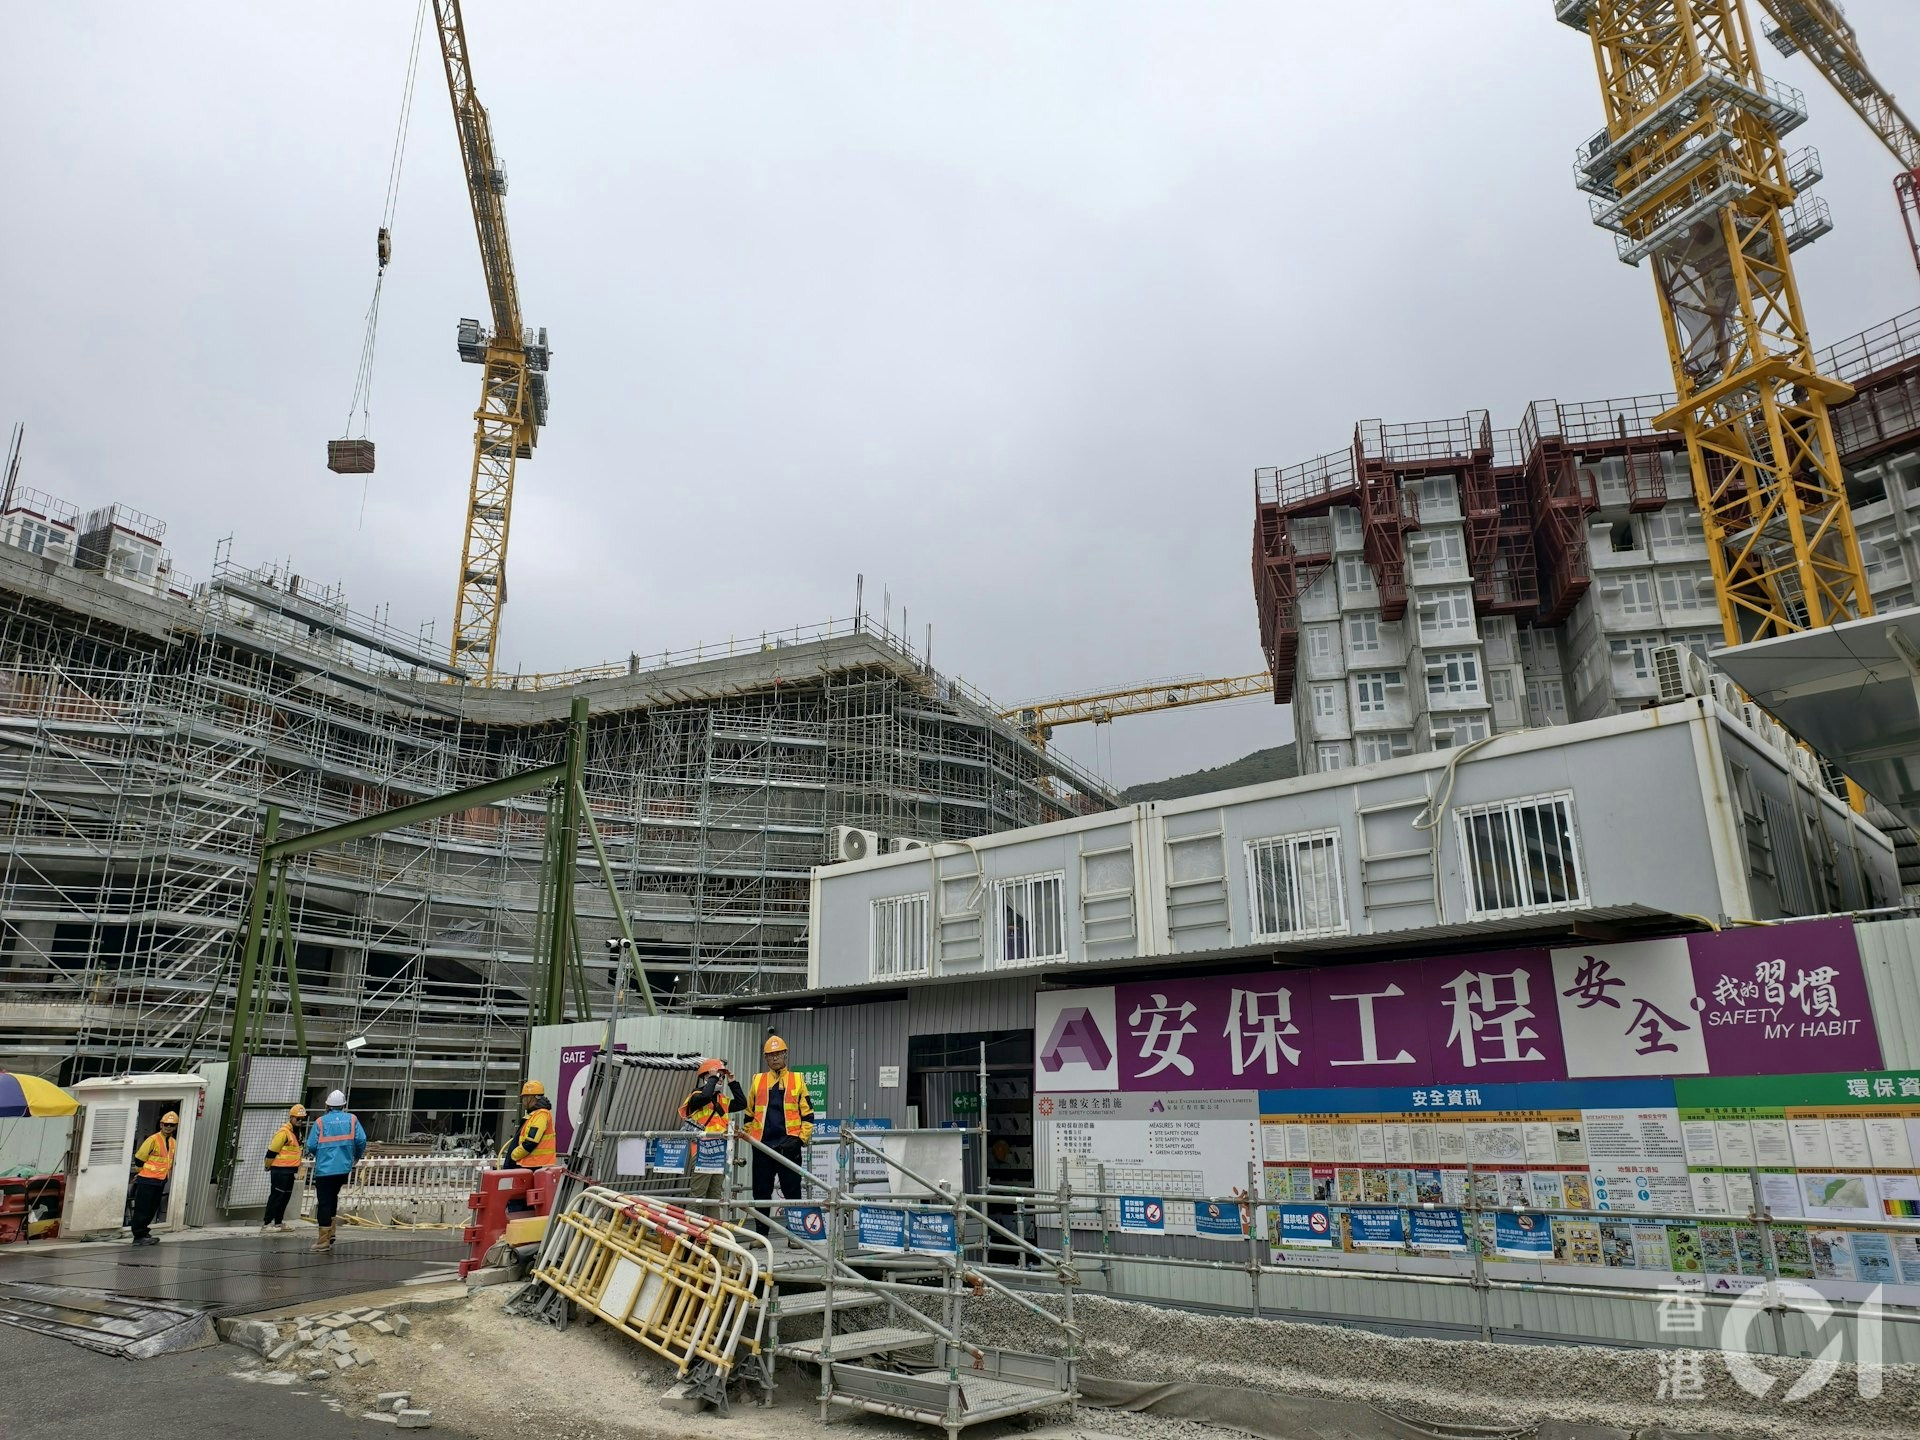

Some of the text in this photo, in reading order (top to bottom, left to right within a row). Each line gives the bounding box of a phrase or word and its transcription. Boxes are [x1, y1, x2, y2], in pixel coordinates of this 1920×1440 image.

[1712, 958, 1840, 1018] 我的習慣
[1563, 955, 1691, 1056] 安全
[1128, 967, 1546, 1078] 安保工程
[1708, 1007, 1783, 1026] SAFETY
[1764, 1019, 1861, 1039] MY HABIT
[562, 1051, 586, 1063] GATE
[1058, 1097, 1122, 1109] 地盤安全措施
[1412, 1089, 1482, 1106] 安全資訊
[827, 1125, 838, 1133] Site
